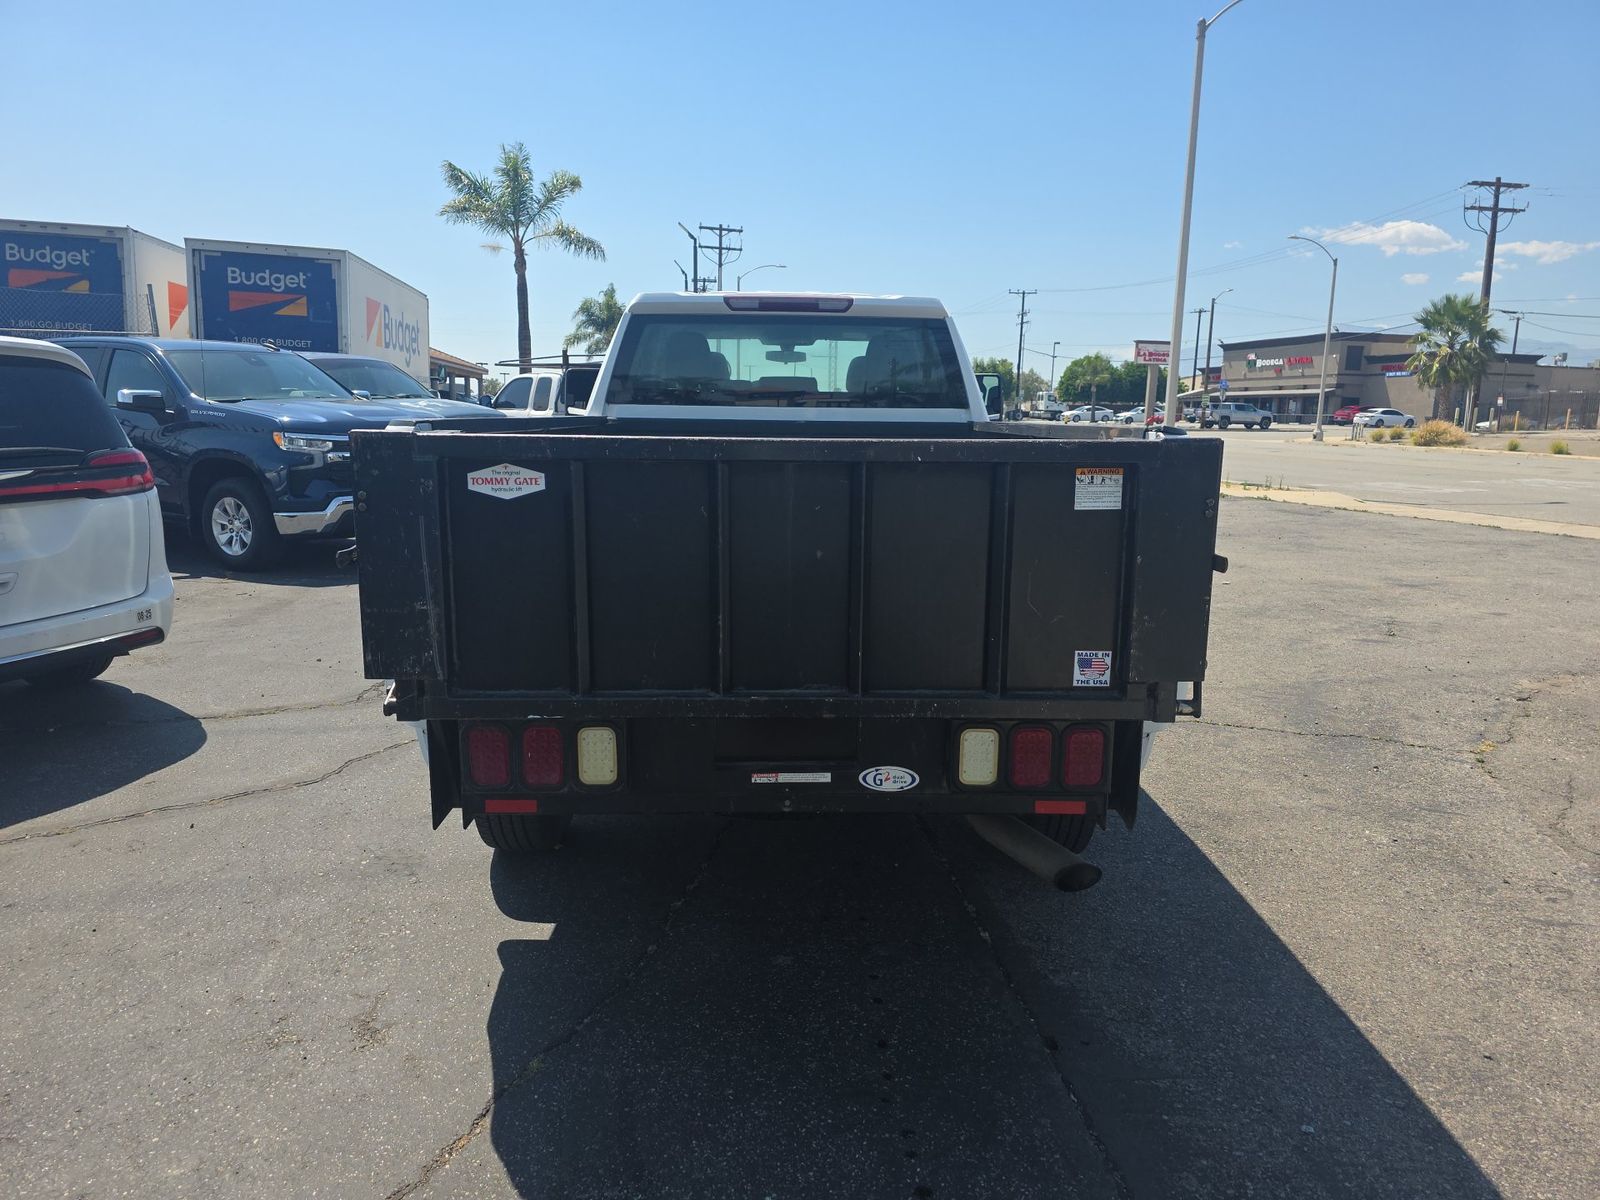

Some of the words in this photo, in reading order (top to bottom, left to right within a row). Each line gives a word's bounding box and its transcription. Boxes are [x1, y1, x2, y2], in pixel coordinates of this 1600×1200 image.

[5, 243, 90, 270] Budget
[227, 266, 307, 292] Budget
[383, 304, 420, 368] Budget
[1256, 358, 1283, 367] BODEGA
[470, 477, 511, 486] TOMMY
[514, 477, 541, 486] GATE
